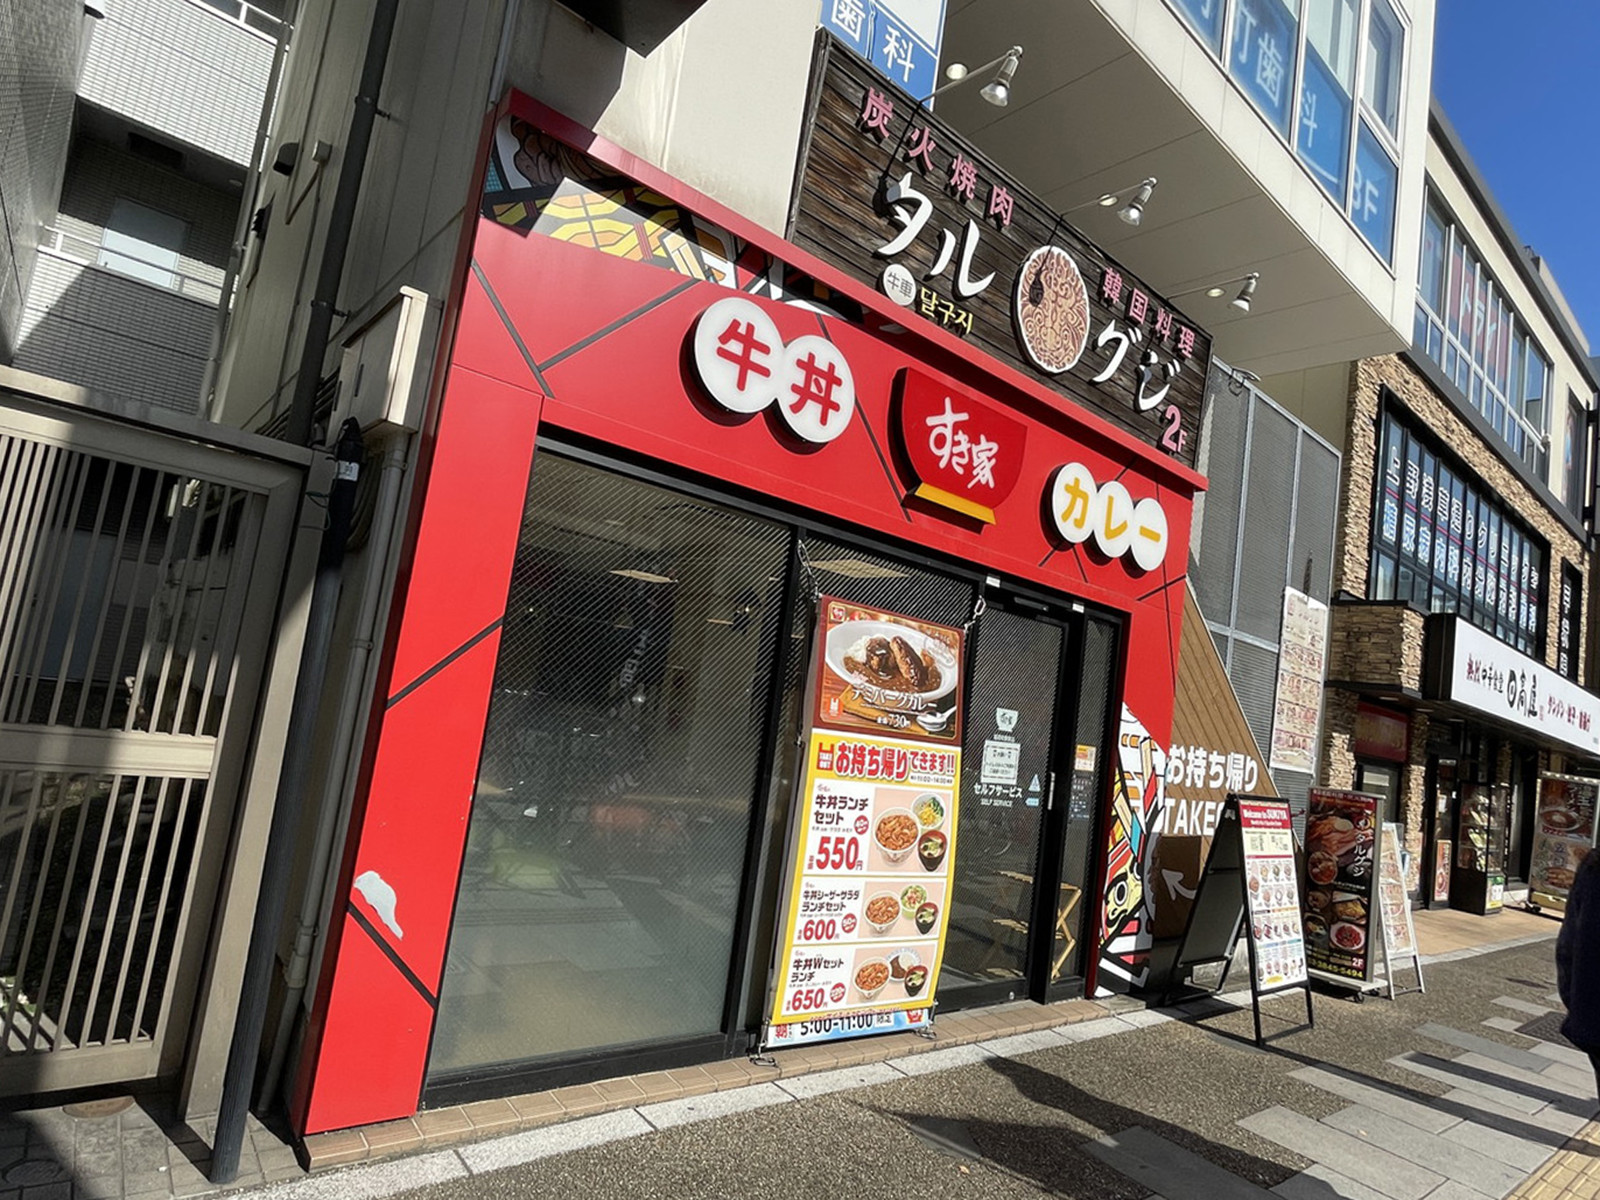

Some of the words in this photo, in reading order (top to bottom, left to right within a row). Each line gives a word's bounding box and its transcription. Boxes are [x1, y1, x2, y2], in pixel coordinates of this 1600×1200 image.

[831, 0, 915, 83] 歯科
[860, 86, 1015, 226] 炭火焼肉
[920, 286, 973, 335] 달구지
[1102, 266, 1196, 358] 韓国料理
[715, 317, 844, 427] 牛丼
[925, 396, 1000, 490] すき家
[1159, 404, 1187, 453] 2F
[1060, 475, 1151, 544] カレー
[974, 782, 1023, 798] セルフサービス
[1165, 744, 1259, 792] お持ち帰り
[814, 810, 844, 826] セット
[815, 794, 869, 811] 牛丼ランチ
[801, 901, 847, 912] ランチセット
[791, 970, 816, 983] ランチ
[792, 957, 845, 971] 牛丼Wセット
